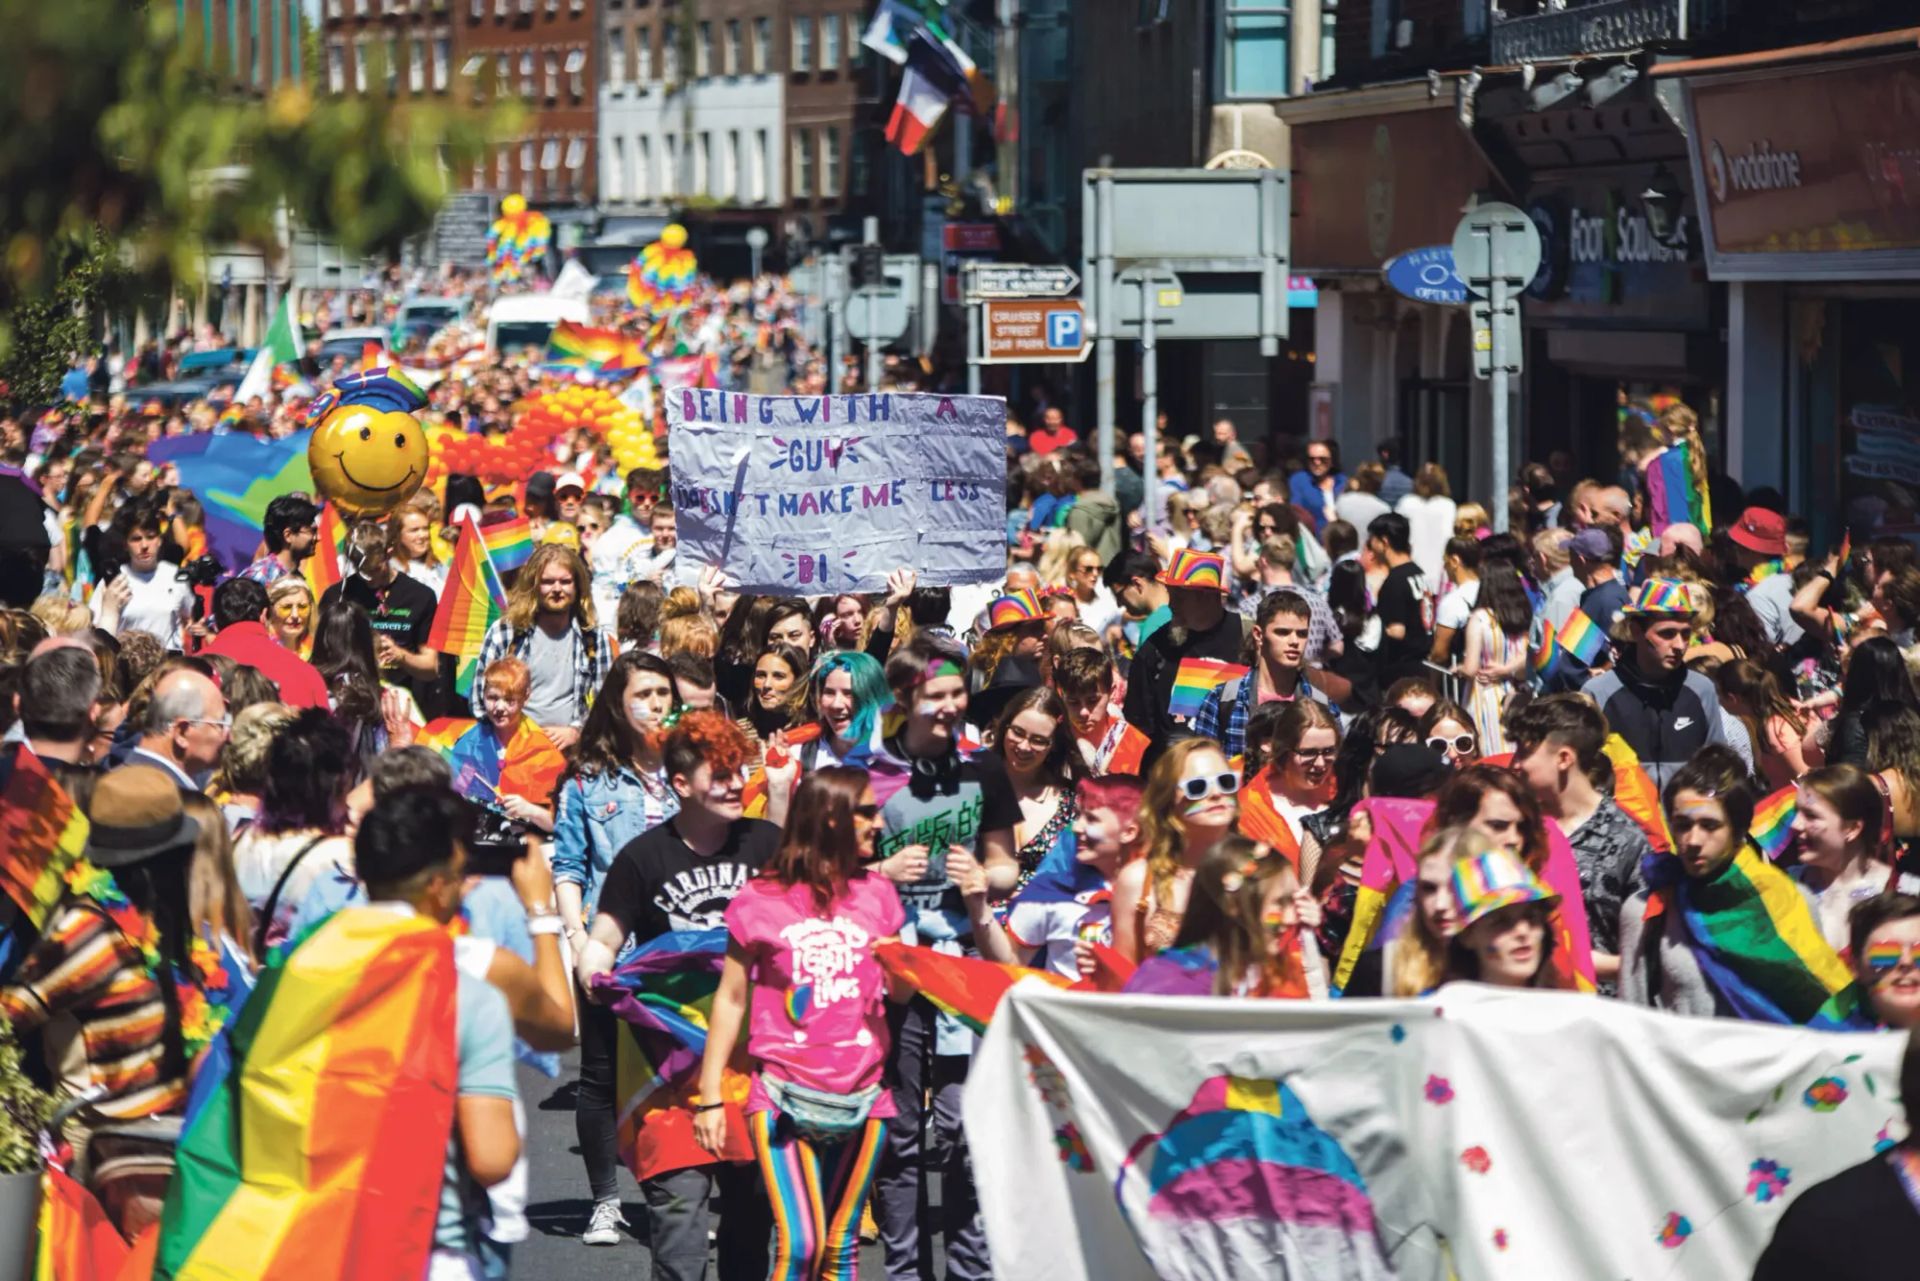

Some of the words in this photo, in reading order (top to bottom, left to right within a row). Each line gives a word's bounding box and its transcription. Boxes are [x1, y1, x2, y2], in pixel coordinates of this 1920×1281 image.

[1728, 138, 1800, 190] vodafone
[996, 325, 1038, 337] STREET
[1054, 316, 1076, 346] P
[682, 390, 774, 424] BEING
[794, 394, 890, 423] WITH
[936, 396, 958, 419] A
[788, 437, 844, 473] GUY
[779, 485, 854, 517] MAKE
[862, 478, 906, 507] ME
[931, 480, 980, 501] LESS
[798, 553, 828, 584] BI
[653, 862, 760, 913] CARDINA
